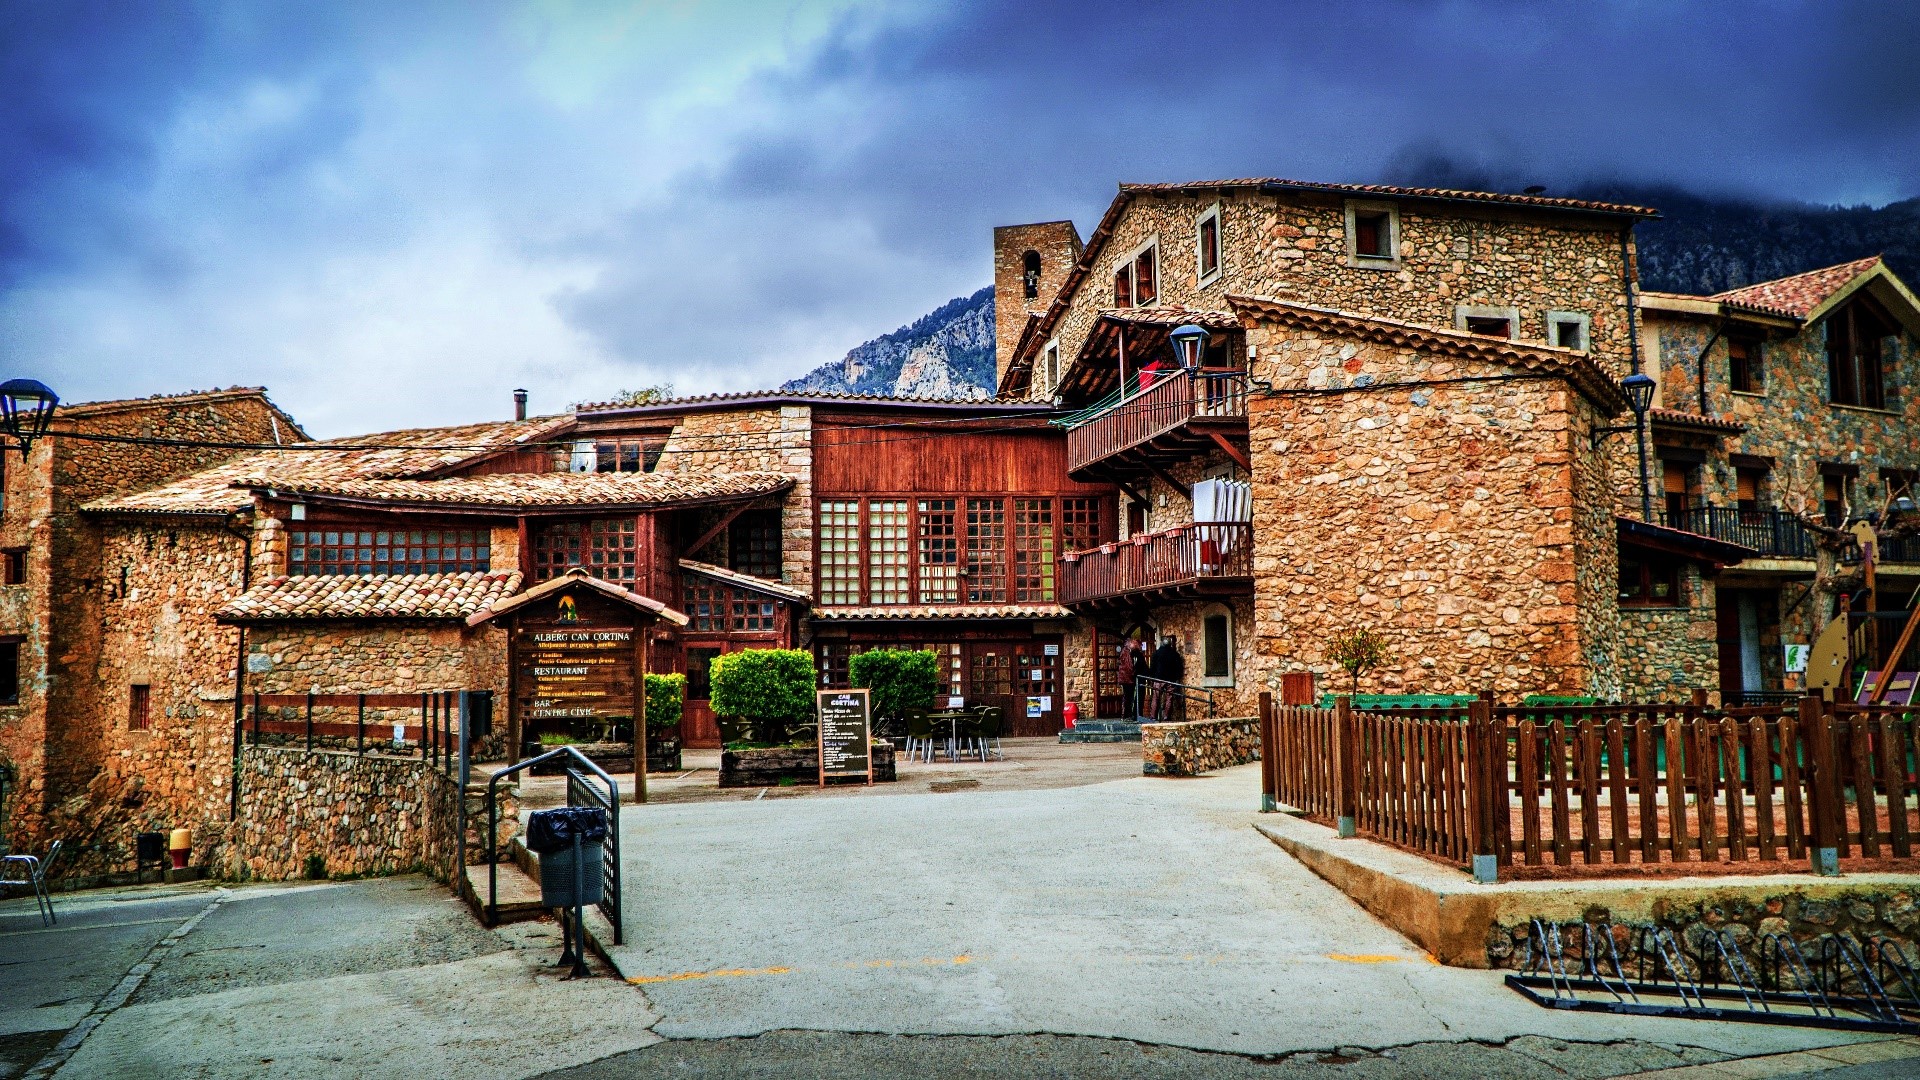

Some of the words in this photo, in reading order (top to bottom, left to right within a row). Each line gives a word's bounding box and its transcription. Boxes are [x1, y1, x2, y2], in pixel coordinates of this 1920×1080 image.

[534, 633, 568, 642] ALBERG
[571, 633, 589, 641] CAN
[593, 632, 630, 641] CORTINA
[534, 667, 589, 676] RESTAURANT
[534, 700, 551, 708] BAR
[830, 699, 860, 707] CORTINA
[533, 708, 568, 717] CENTRE
